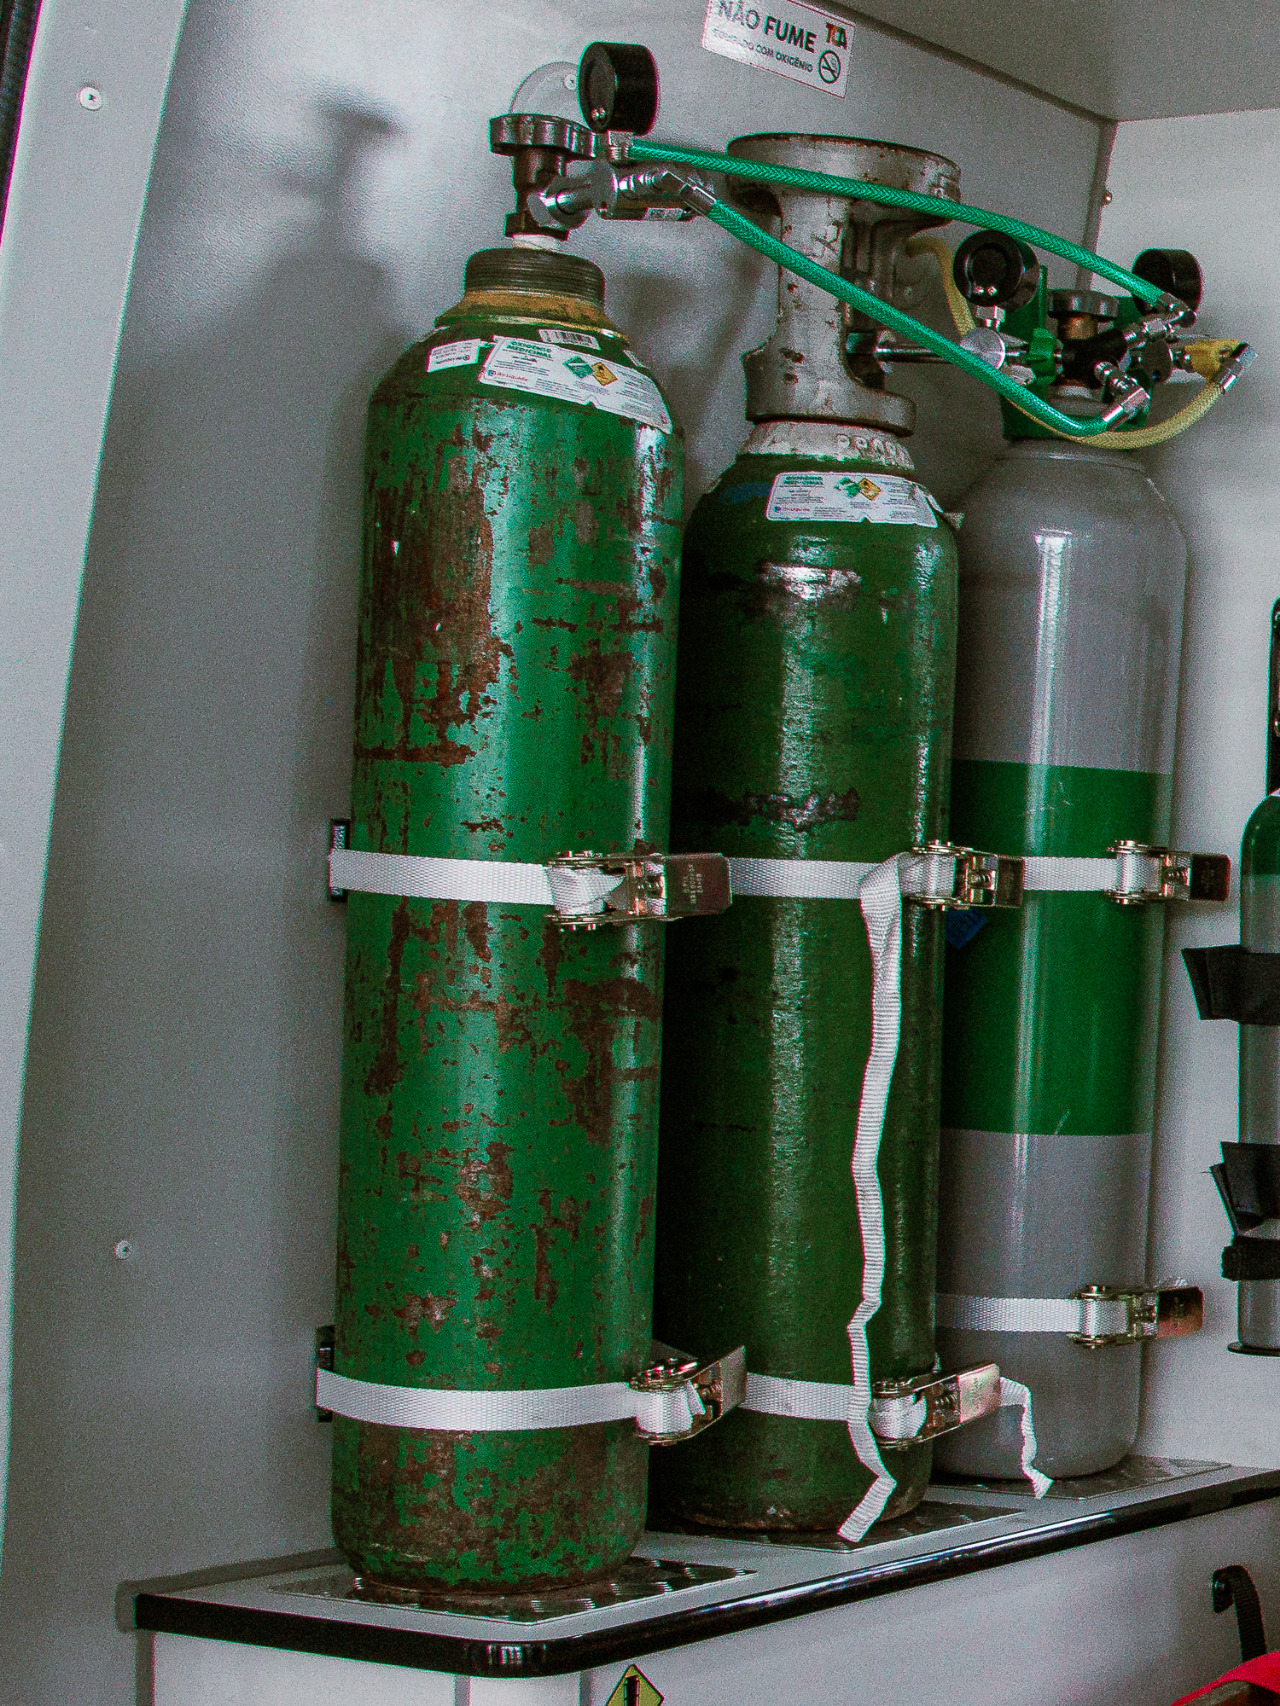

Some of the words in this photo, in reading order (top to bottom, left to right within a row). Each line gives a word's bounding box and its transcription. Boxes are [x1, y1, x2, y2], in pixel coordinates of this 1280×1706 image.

[763, 14, 817, 54] FUME
[755, 42, 774, 58] COM
[775, 50, 813, 73] OXIGÊNIO
